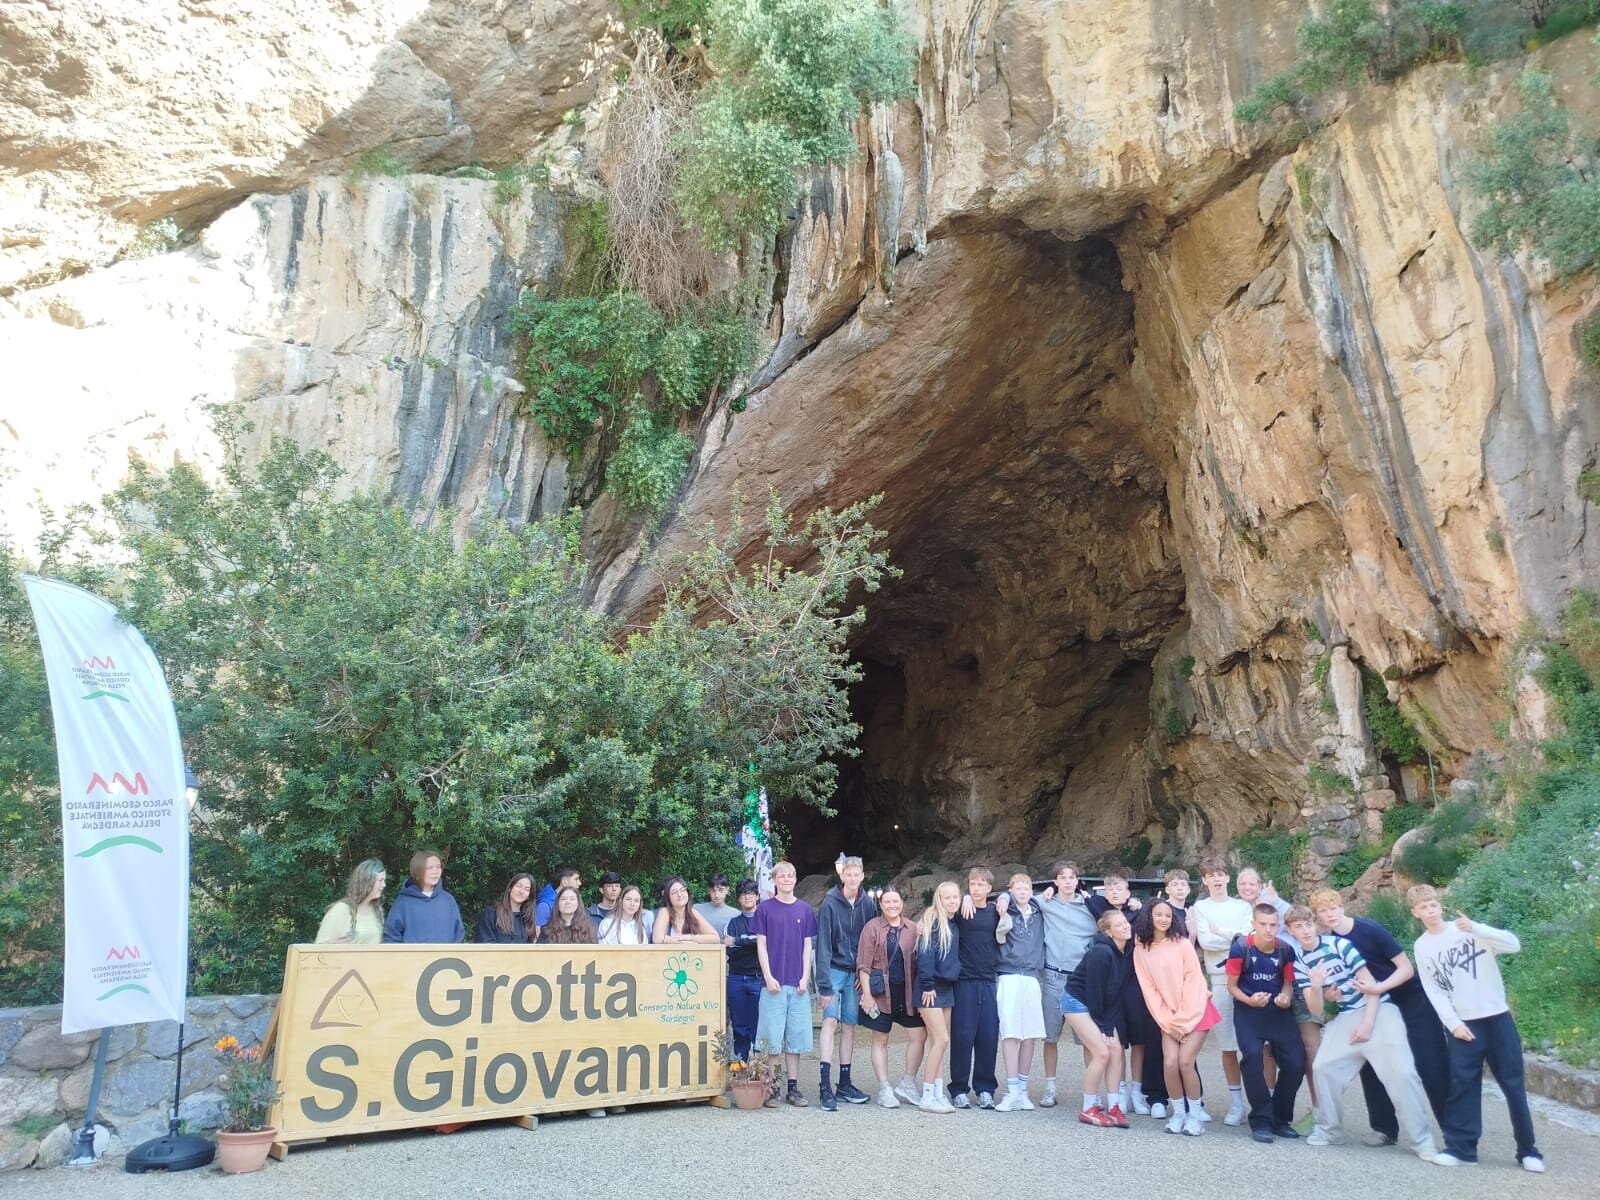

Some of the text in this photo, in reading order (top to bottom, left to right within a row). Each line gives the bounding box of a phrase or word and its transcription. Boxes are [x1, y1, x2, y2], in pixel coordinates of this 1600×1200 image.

[416, 957, 638, 1027] Grotta
[638, 1002, 674, 1012] Consorzio
[676, 1001, 701, 1010] Natura
[660, 1014, 695, 1025] Sardegna
